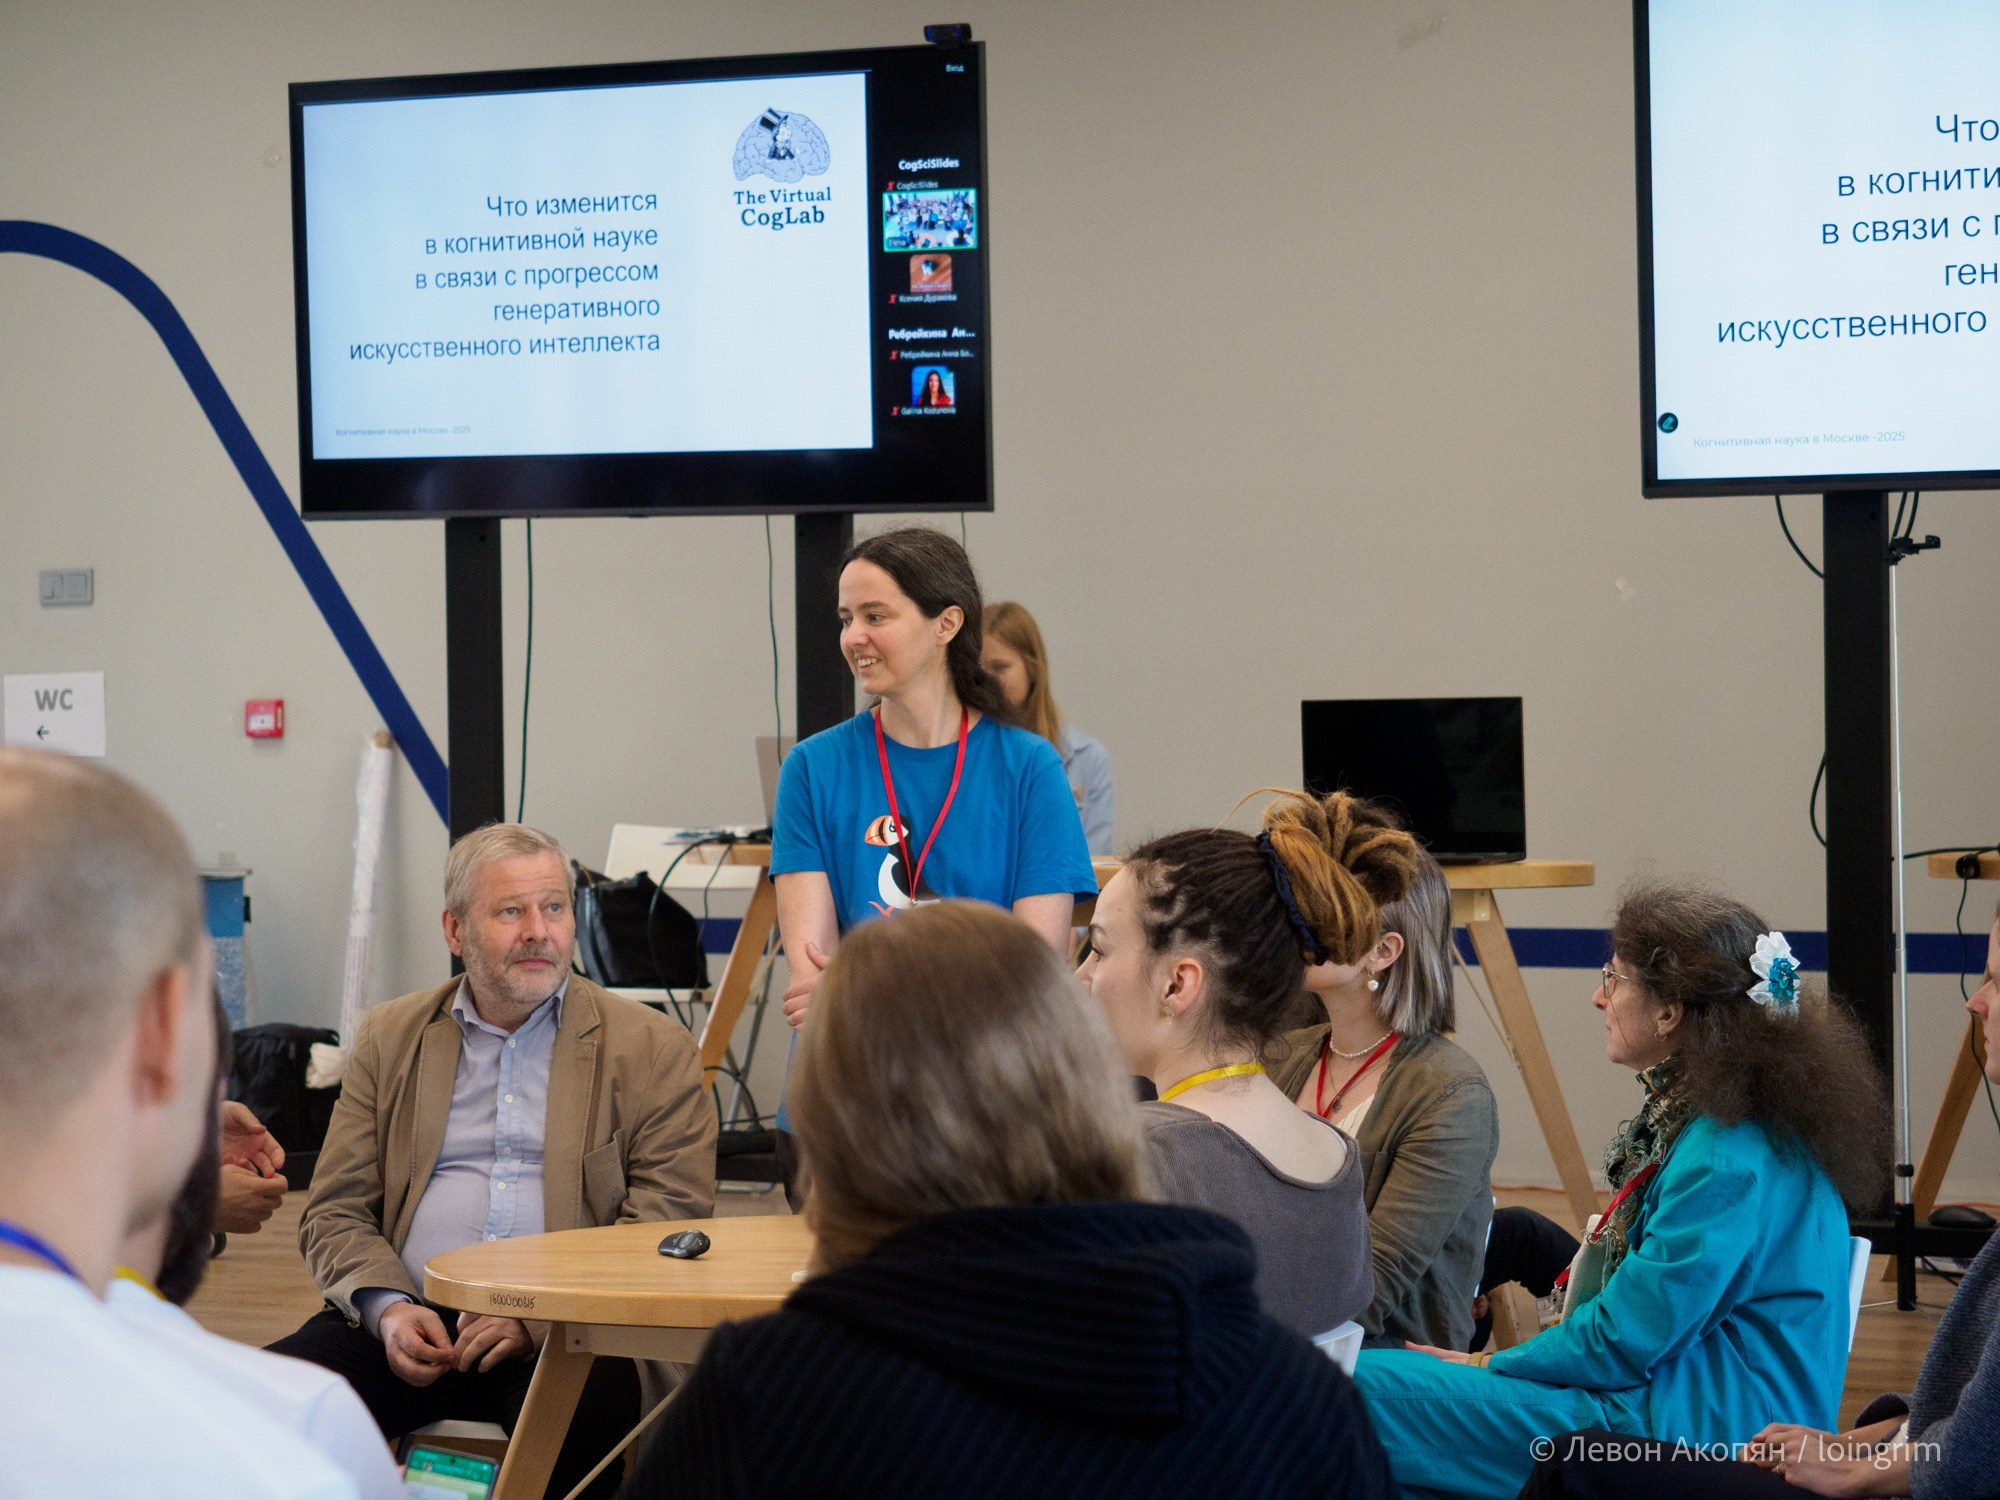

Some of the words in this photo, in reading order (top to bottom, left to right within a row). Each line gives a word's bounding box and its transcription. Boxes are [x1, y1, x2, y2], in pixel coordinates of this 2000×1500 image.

[1936, 113, 2000, 143] Что
[898, 157, 960, 172] CogSciSlides
[733, 190, 767, 205] The
[769, 185, 832, 204] Virtual
[896, 180, 939, 191] CogSciSlides
[1838, 176, 1856, 197] в
[1868, 167, 2000, 195] когнити
[486, 195, 528, 217] Что
[536, 193, 658, 216] изменится
[741, 205, 826, 231] CogLab
[425, 238, 437, 255] в
[445, 227, 585, 254] когнитивной
[593, 228, 658, 252] науке
[1821, 223, 1840, 244] в
[1852, 217, 1950, 243] связи
[1962, 215, 1982, 238] с
[415, 273, 427, 289] в
[435, 269, 497, 288] связи
[504, 269, 517, 287] с
[524, 264, 659, 290] прогрессом
[1944, 262, 1999, 286] ген
[493, 298, 661, 324] генеративного
[888, 328, 948, 342] Ребрейкина
[1717, 310, 1987, 348] искусственного
[350, 338, 522, 364] искусственного
[529, 333, 661, 355] интеллекта
[1693, 436, 1772, 448] Когнитивная
[1774, 435, 1810, 447] наука
[1812, 436, 1820, 445] в
[1823, 433, 1869, 444] Москве
[1872, 431, 1906, 442] -2025
[34, 688, 73, 711] WC
